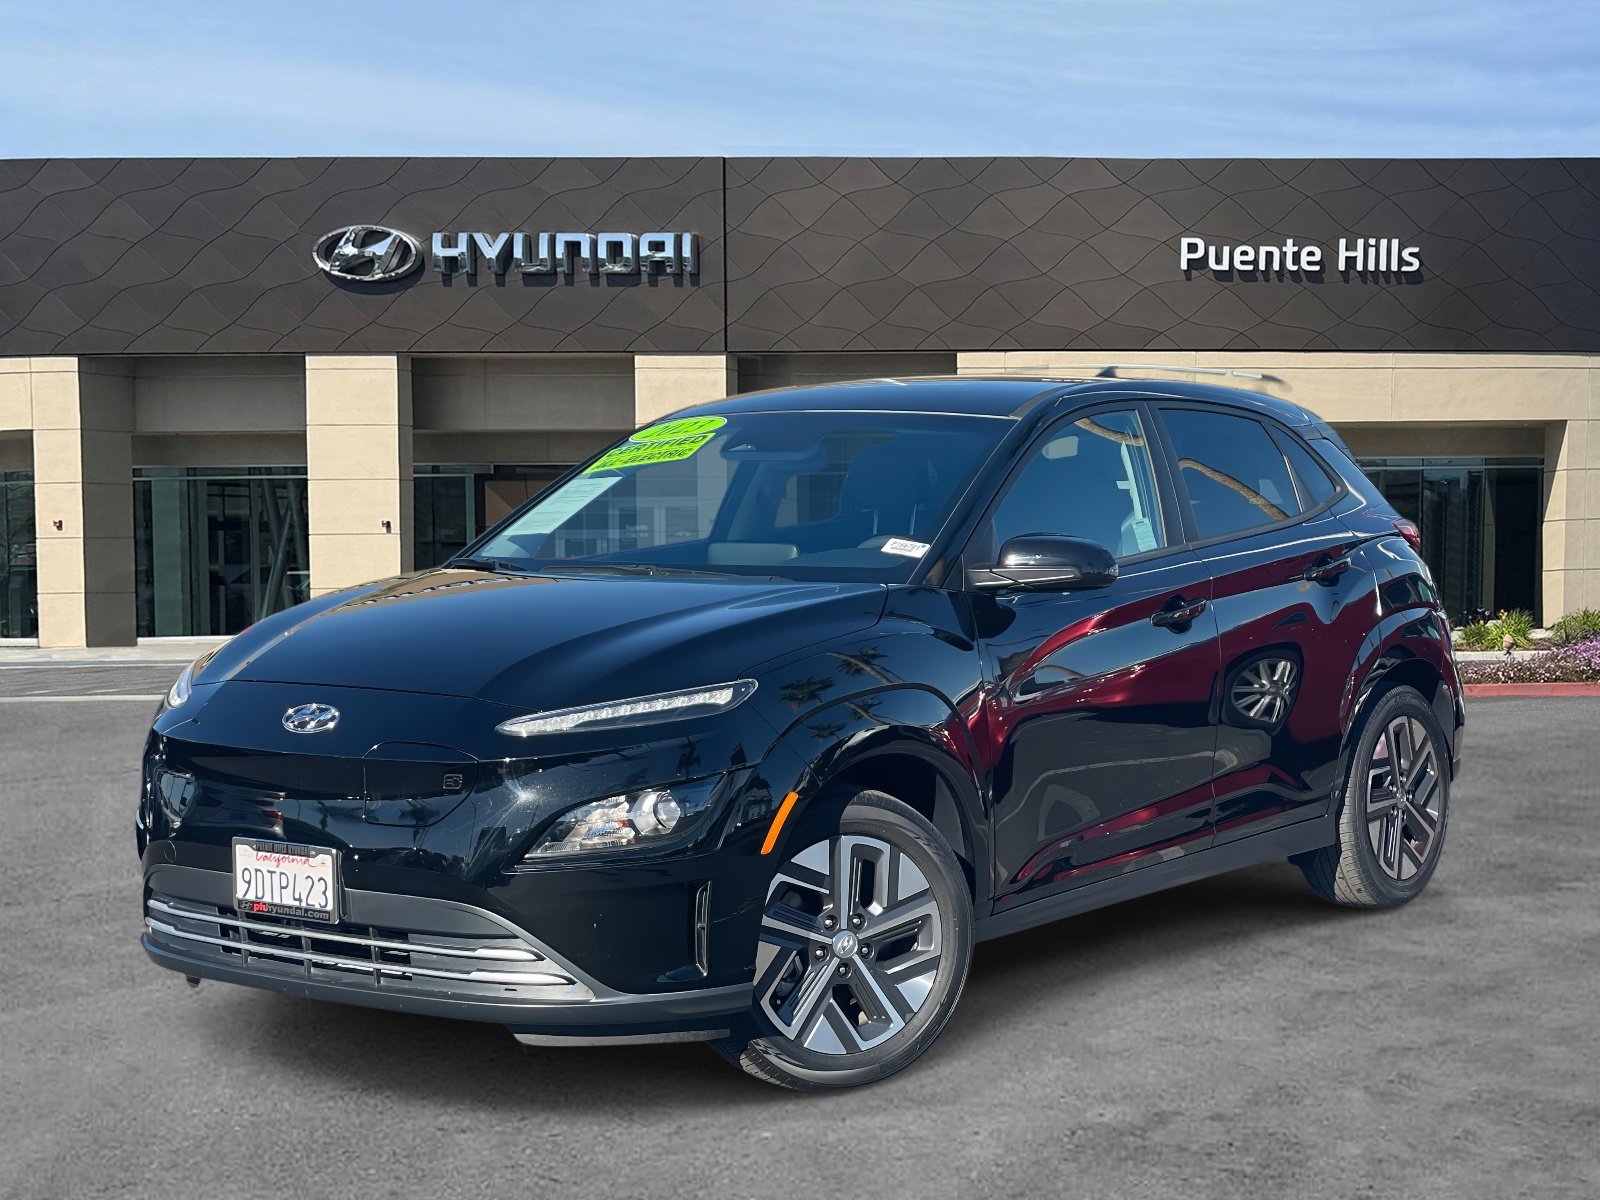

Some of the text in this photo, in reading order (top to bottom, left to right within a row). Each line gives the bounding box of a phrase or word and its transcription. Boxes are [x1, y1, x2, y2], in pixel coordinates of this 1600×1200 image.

[431, 231, 699, 275] HYUNDAI
[1180, 237, 1421, 272] Puente Hills
[605, 433, 711, 458] CERTIFIED
[241, 866, 329, 909] 9DTP423
